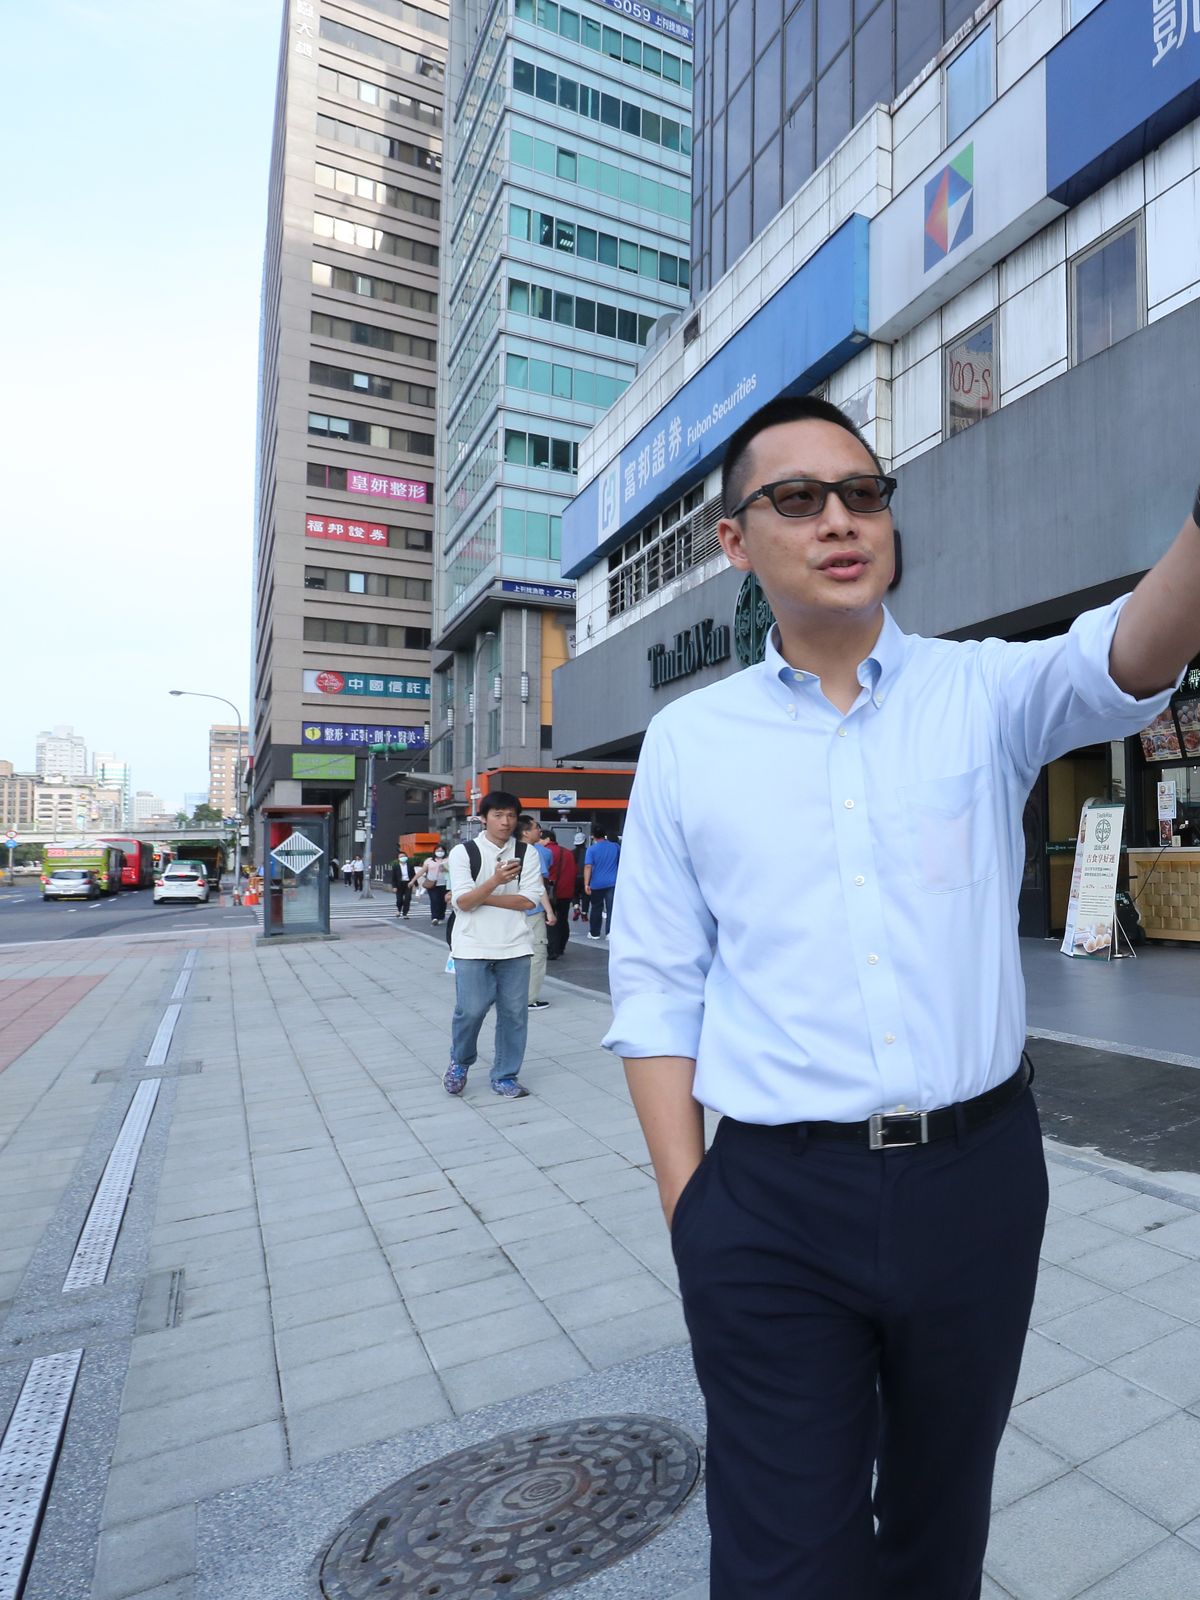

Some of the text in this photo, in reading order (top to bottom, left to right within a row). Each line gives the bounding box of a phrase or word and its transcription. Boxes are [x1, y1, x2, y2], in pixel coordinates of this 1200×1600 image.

[624, 373, 757, 503] 富邦證券 Fubon Securities
[351, 475, 425, 499] 皇妍整形
[306, 519, 386, 541] 福邦證券
